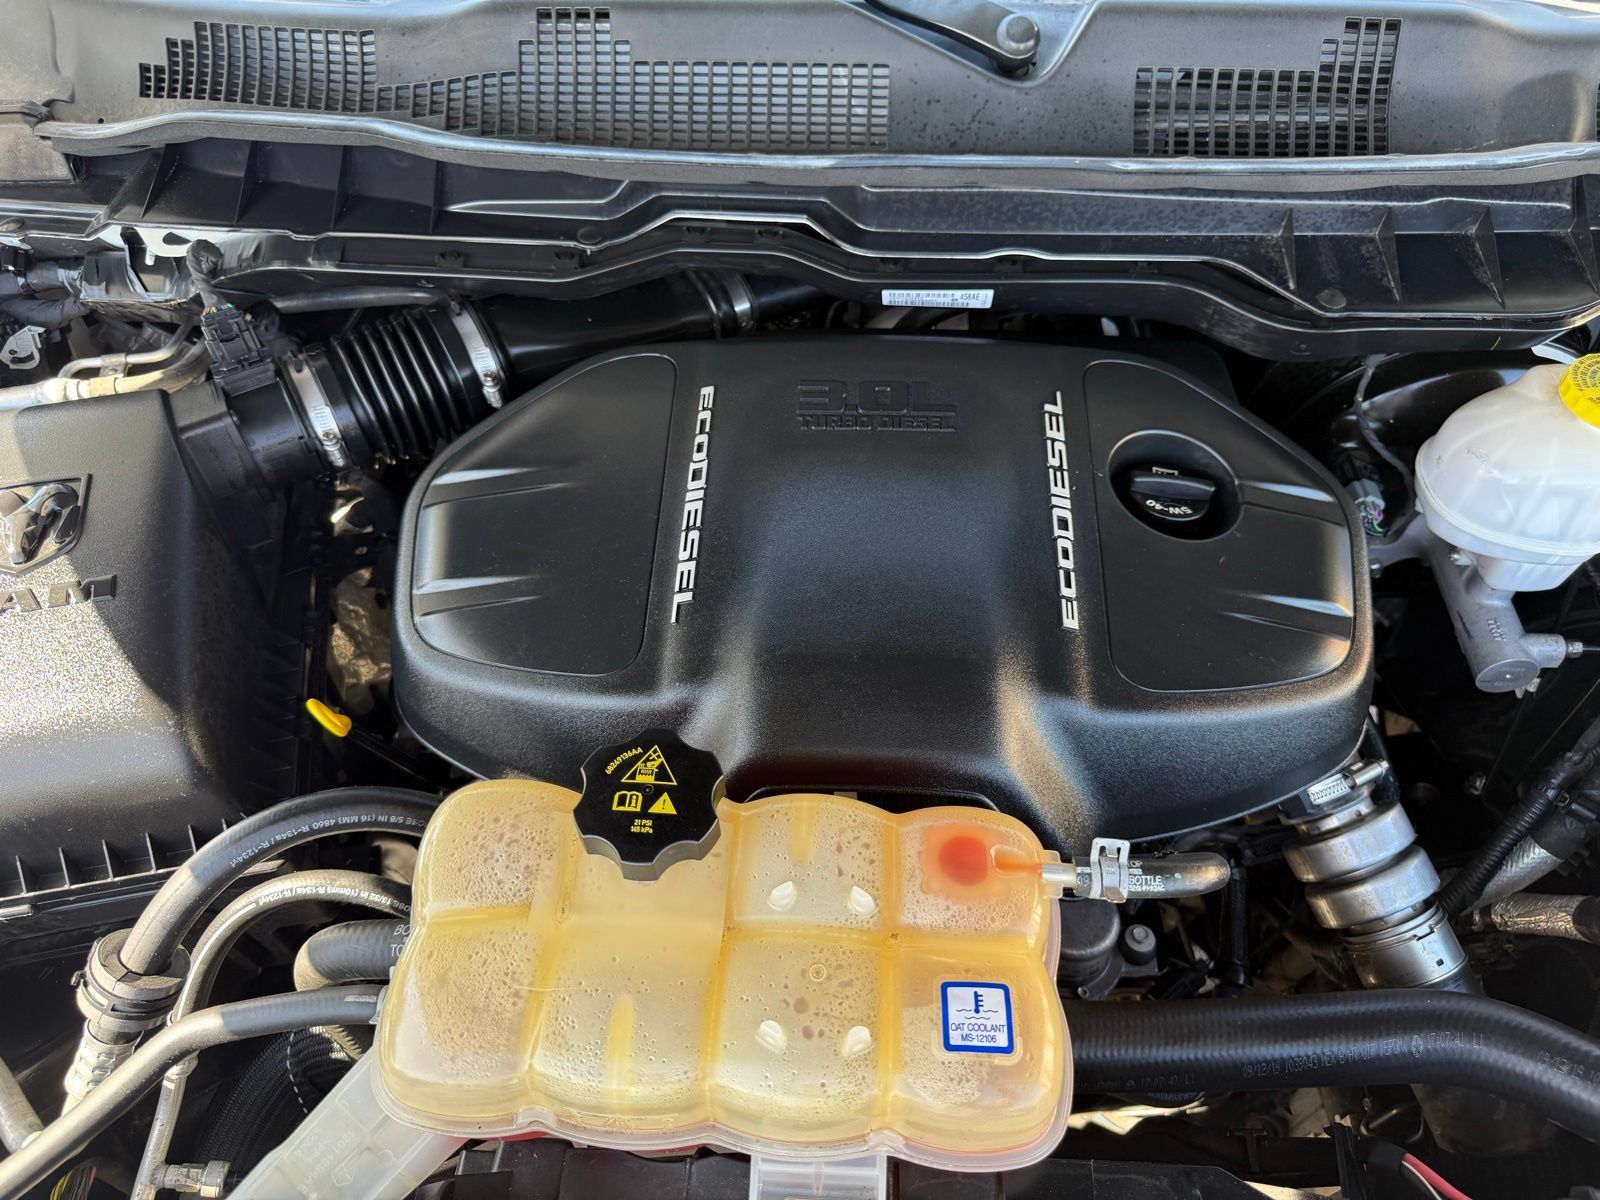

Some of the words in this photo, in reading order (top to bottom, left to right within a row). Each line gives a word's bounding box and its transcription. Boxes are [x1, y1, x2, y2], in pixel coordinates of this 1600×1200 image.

[797, 415, 872, 431] TURBO
[877, 416, 957, 433] DIESEL
[671, 385, 715, 624] ECODIESEL
[1044, 390, 1080, 630] ECODIESEL
[1145, 499, 1194, 515] 5W-40
[604, 746, 643, 775] 68249136AA
[312, 818, 336, 830] 4860
[339, 815, 358, 825] MM)
[360, 815, 376, 823] (16
[377, 815, 389, 823] IN
[389, 815, 404, 824] 5/8
[405, 817, 427, 828] OSE
[641, 819, 653, 827] PSI
[275, 823, 310, 841] R-134a
[630, 825, 641, 833] 145
[641, 826, 653, 834] kPa
[229, 840, 270, 868] R-1234yf
[1128, 860, 1143, 868] OP
[1128, 875, 1162, 885] BOTTLE
[326, 885, 360, 897] (10mm)
[369, 891, 392, 906] 13/32
[393, 901, 412, 912] OSE
[950, 1022, 966, 1032] OAT
[967, 1022, 1006, 1033] COOLANT
[961, 1033, 997, 1043] MS-12106
